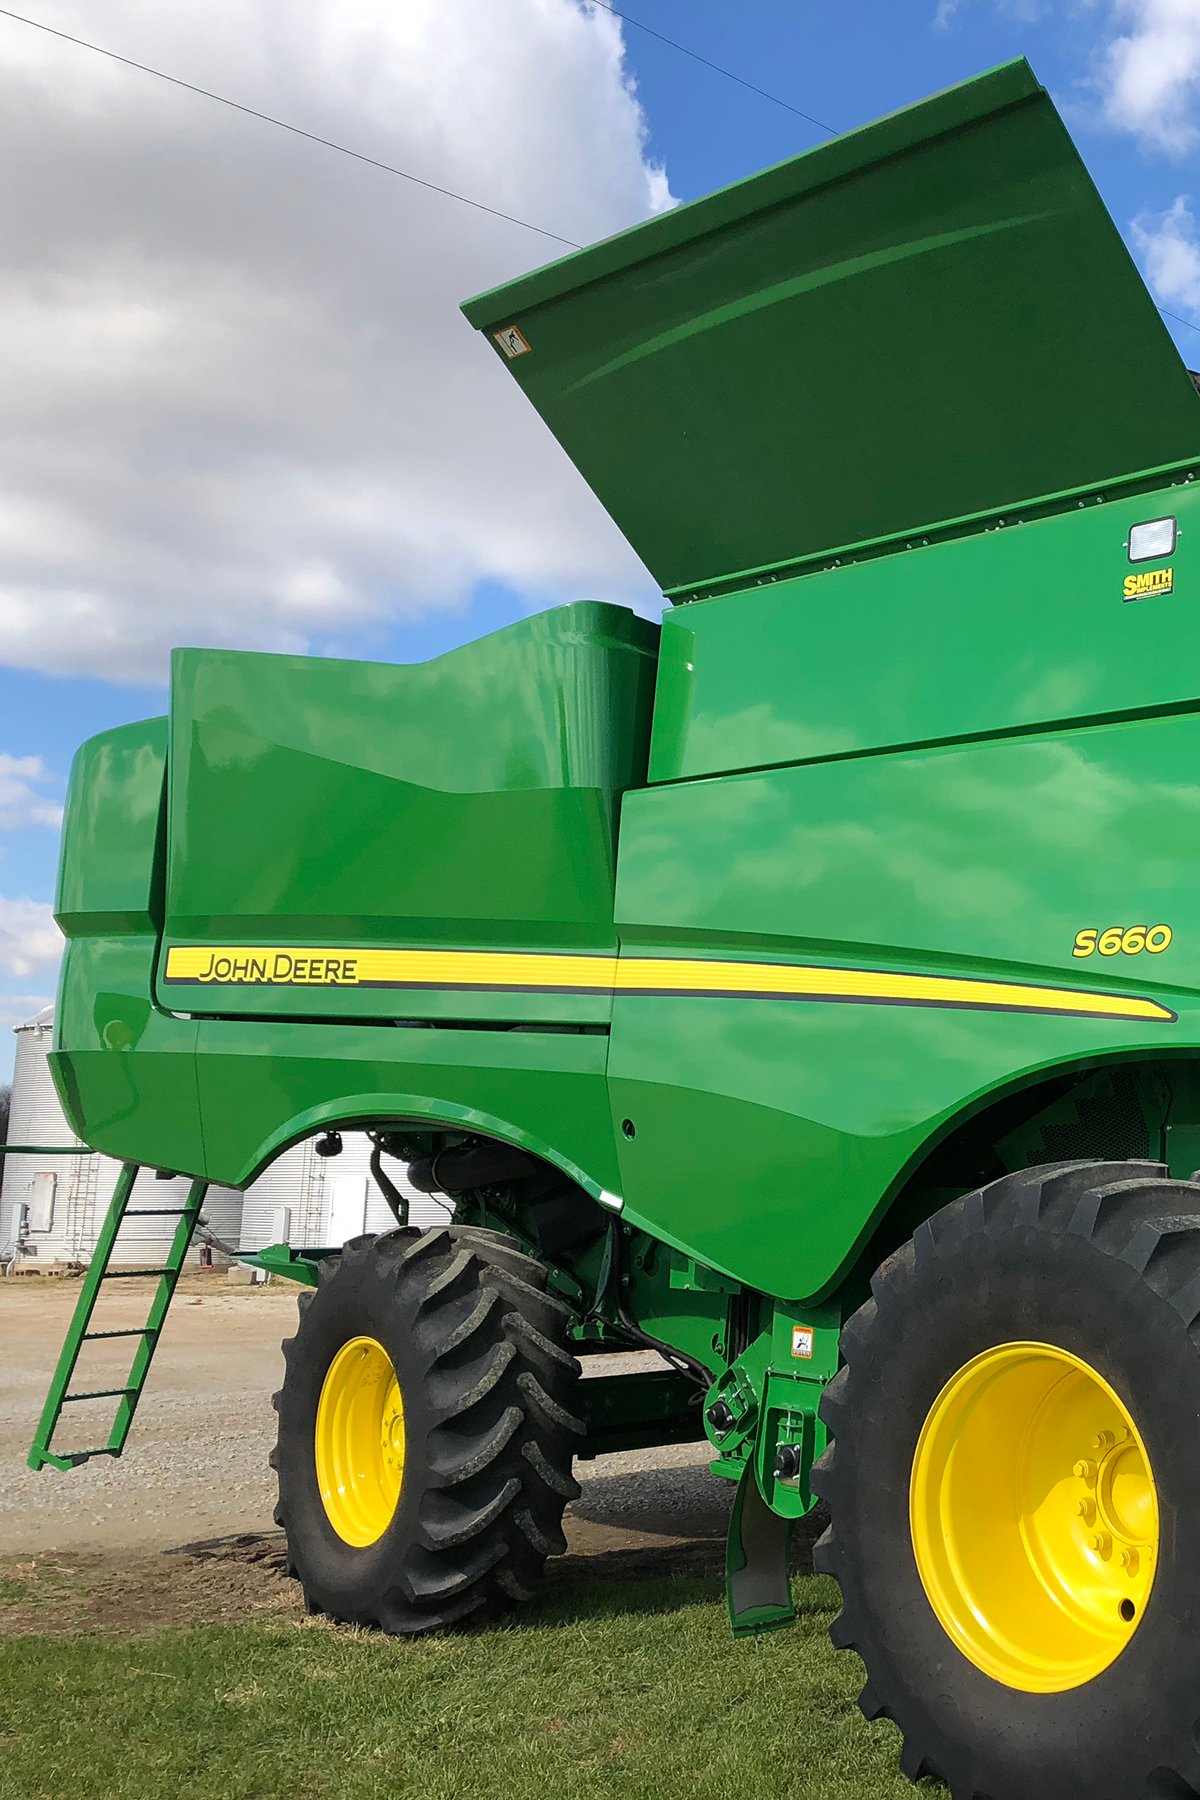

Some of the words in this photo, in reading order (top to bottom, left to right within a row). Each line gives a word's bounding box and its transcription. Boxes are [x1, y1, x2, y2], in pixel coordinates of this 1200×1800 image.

[1123, 568, 1173, 596] SMITH
[1072, 923, 1173, 958] S660
[199, 953, 267, 979] JOHN
[273, 954, 358, 980] DEERE
